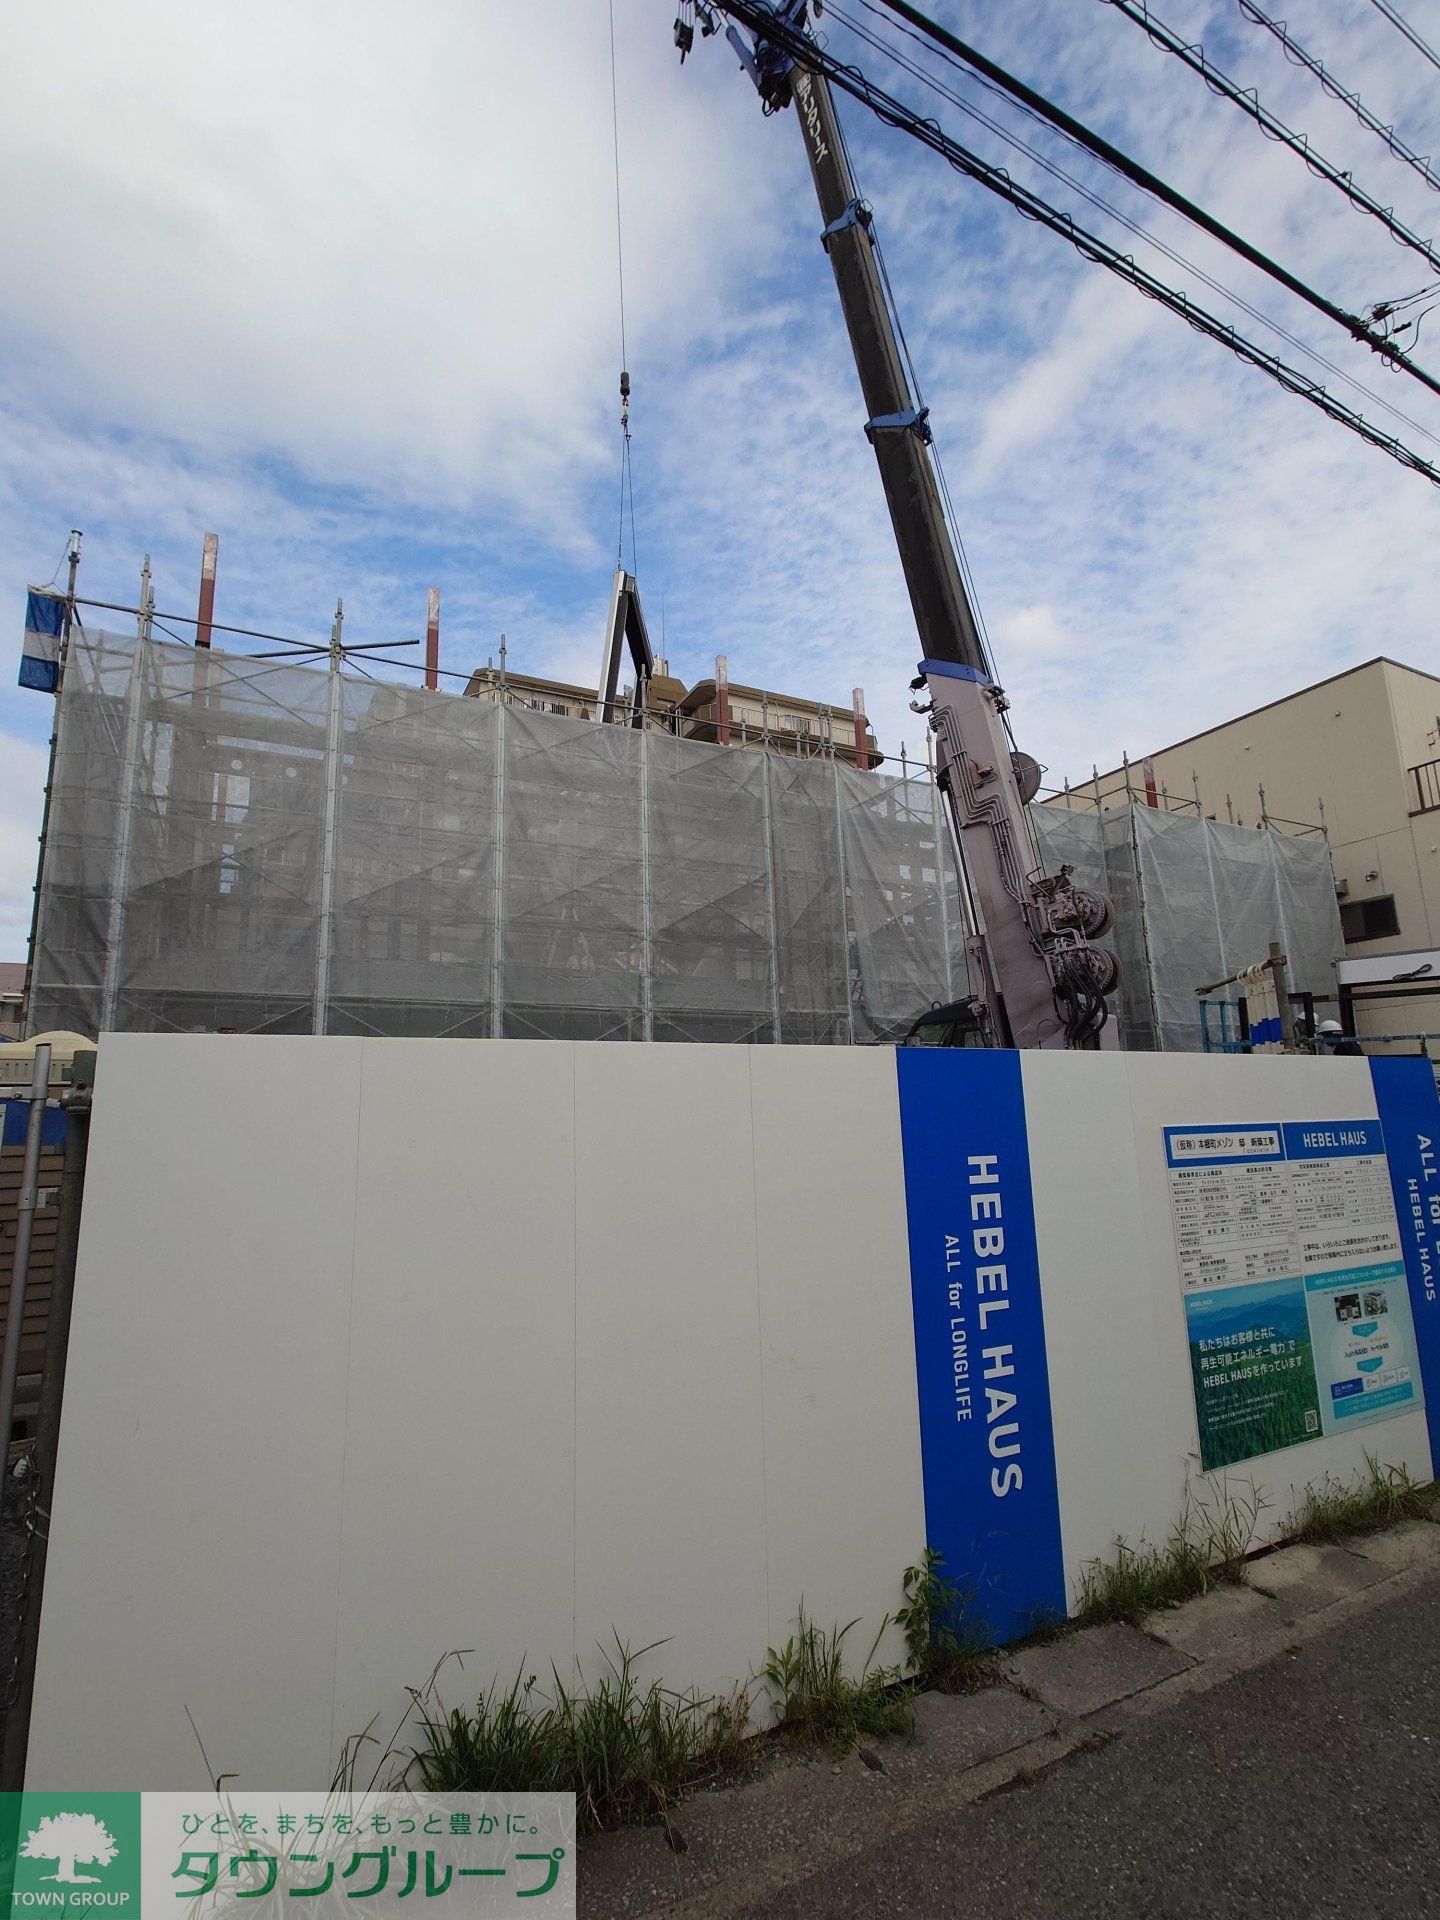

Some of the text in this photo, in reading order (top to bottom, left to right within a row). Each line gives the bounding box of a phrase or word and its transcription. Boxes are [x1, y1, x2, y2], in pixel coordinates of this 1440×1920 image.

[1303, 1130, 1367, 1148] HEBEL HAUS
[1417, 1134, 1438, 1182] ALL
[1408, 1178, 1426, 1243] HEBEL
[1419, 1247, 1436, 1301] HAUS
[945, 1234, 972, 1422] ALL for LONGLIFE
[967, 1155, 1023, 1498] HEBEL HAUS
[1199, 1327, 1276, 1352] 私たちはお客様と共に
[1203, 1373, 1230, 1388] HEBEL
